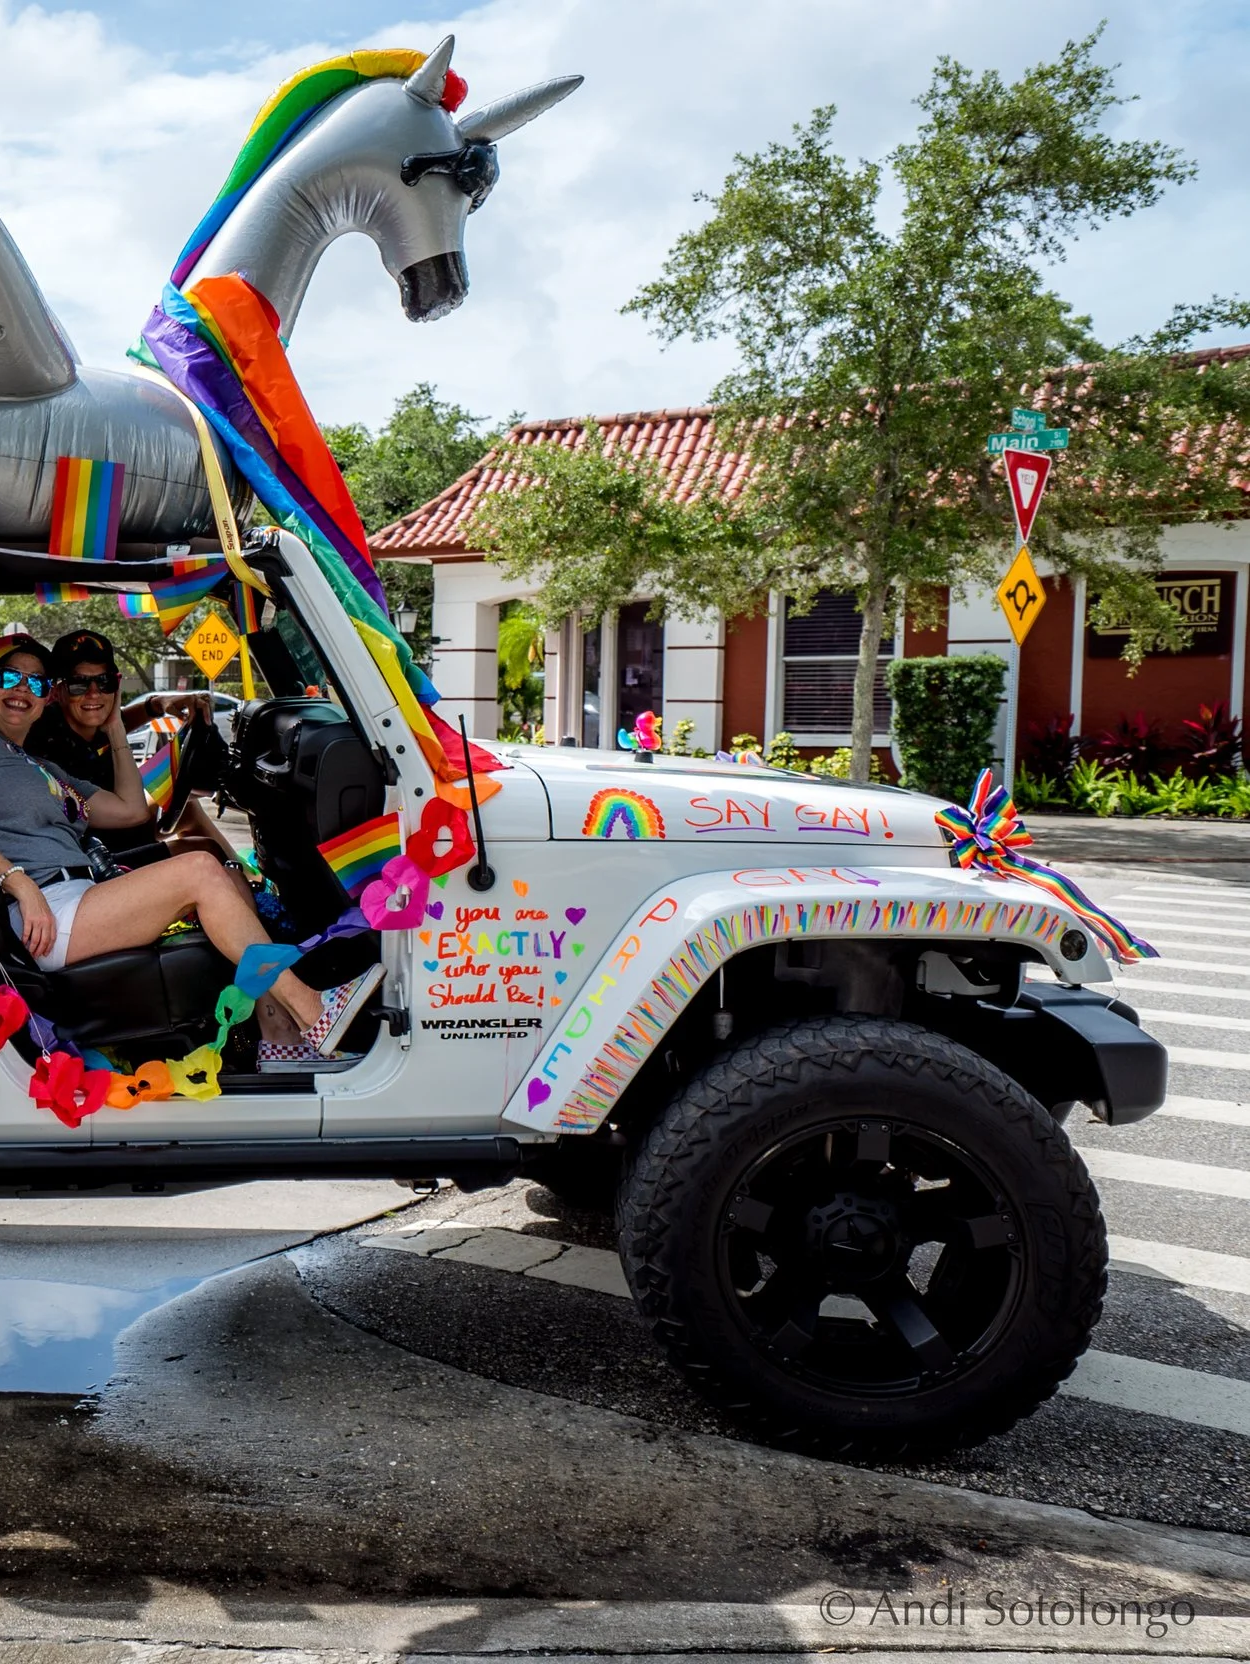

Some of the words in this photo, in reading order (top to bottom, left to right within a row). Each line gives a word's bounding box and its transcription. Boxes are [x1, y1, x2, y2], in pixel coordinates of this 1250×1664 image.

[991, 435, 1039, 450] Main
[1021, 473, 1035, 485] YIELD
[197, 632, 228, 645] DEAD
[201, 650, 224, 661] END
[685, 797, 775, 827] SAY
[455, 905, 500, 933] you
[515, 909, 549, 921] are
[437, 930, 566, 960] EXACTLY
[443, 957, 488, 979] who
[499, 965, 542, 988] you
[420, 1017, 543, 1030] WRANGLER
[440, 1031, 528, 1040] UNLIMITED
